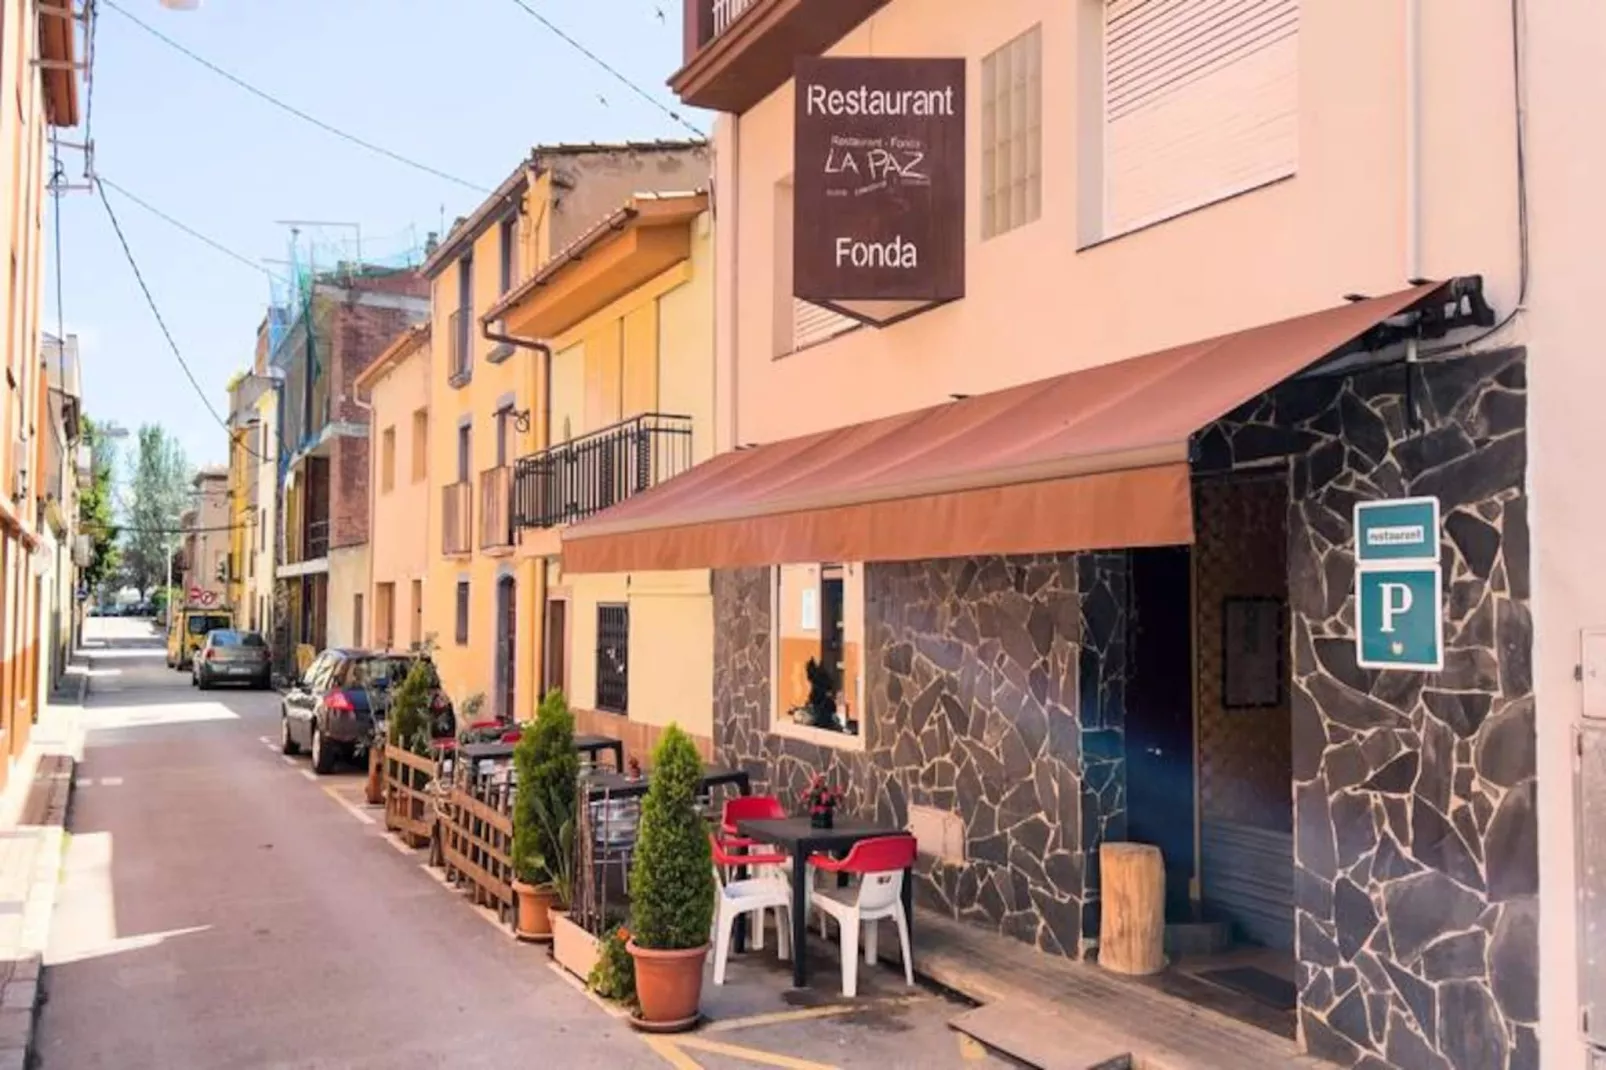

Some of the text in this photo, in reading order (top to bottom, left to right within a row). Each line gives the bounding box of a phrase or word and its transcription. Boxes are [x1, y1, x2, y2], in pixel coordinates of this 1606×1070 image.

[807, 85, 954, 115] Restaurant
[824, 147, 929, 180] LA PAZ
[836, 236, 917, 268] Fonda
[1378, 582, 1413, 632] P
